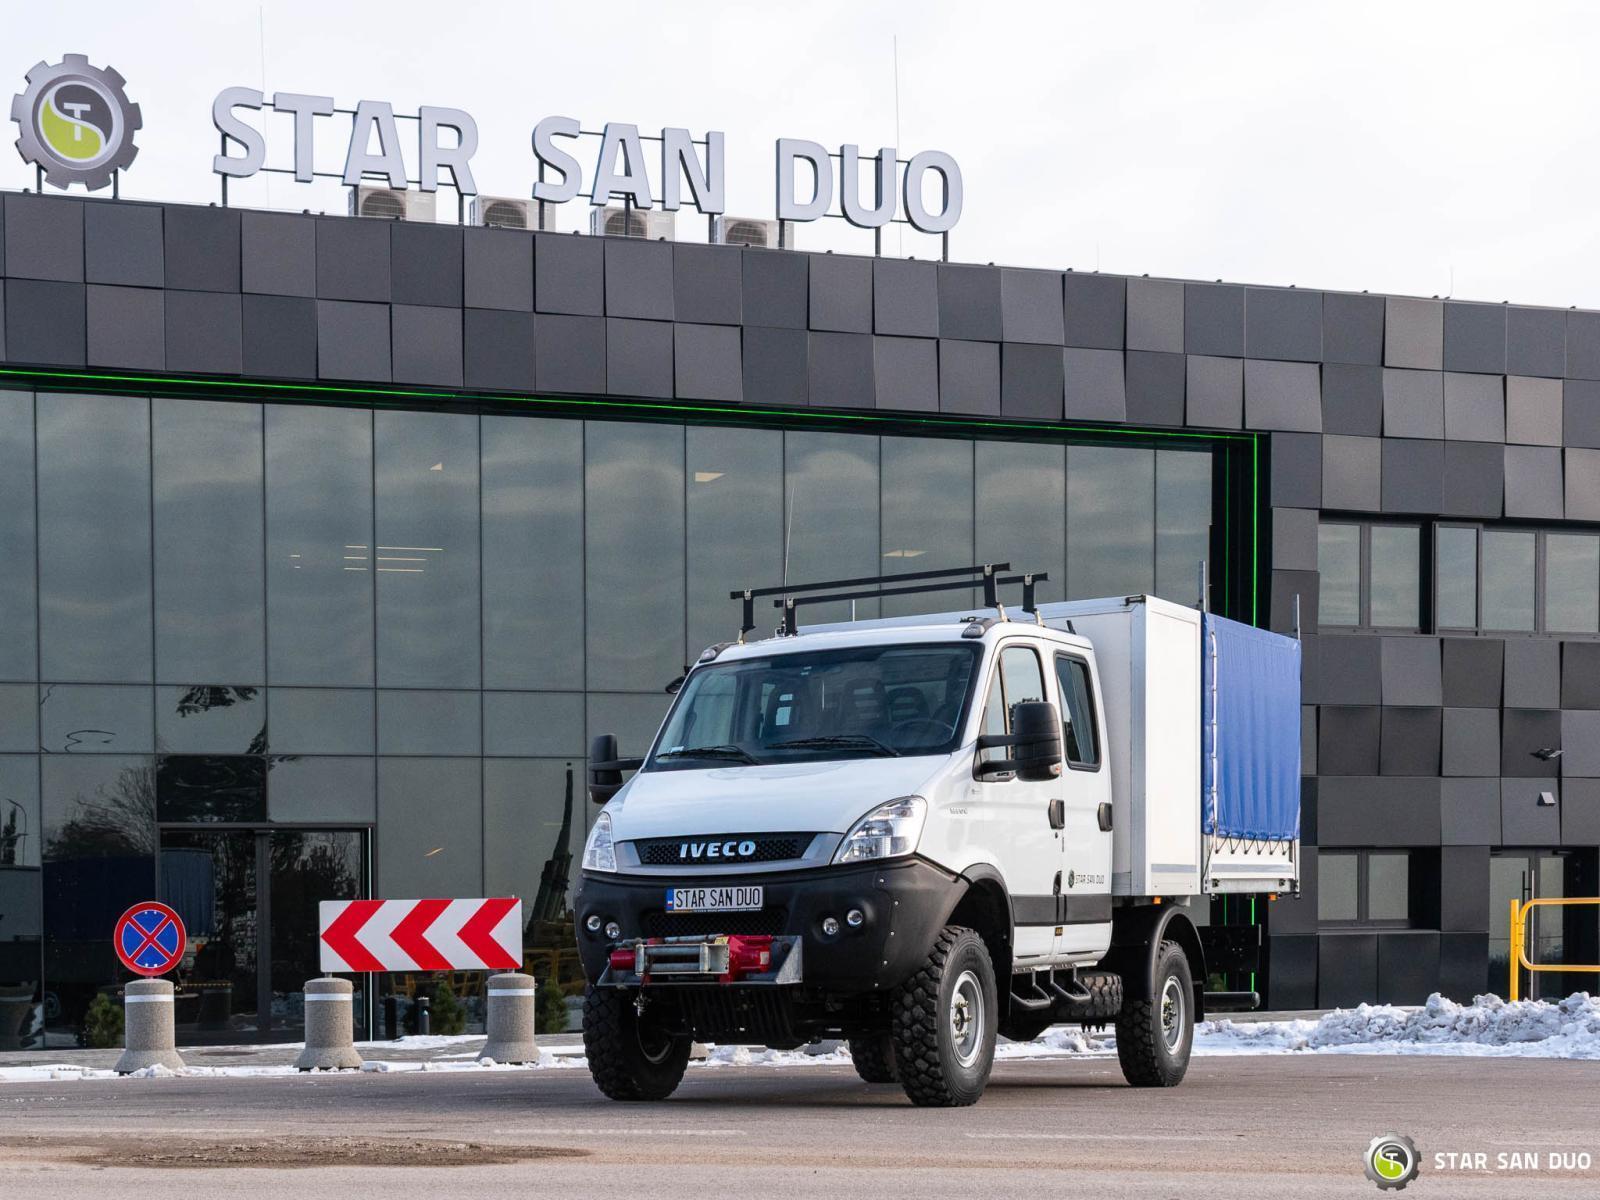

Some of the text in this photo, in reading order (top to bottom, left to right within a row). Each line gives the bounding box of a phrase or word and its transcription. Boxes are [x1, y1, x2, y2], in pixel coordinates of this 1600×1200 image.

[212, 86, 963, 234] STAR SAN DUO
[679, 840, 756, 858] IVECO
[1075, 874, 1105, 884] STAR SAN DUO
[676, 888, 760, 908] STAR SAN DUO
